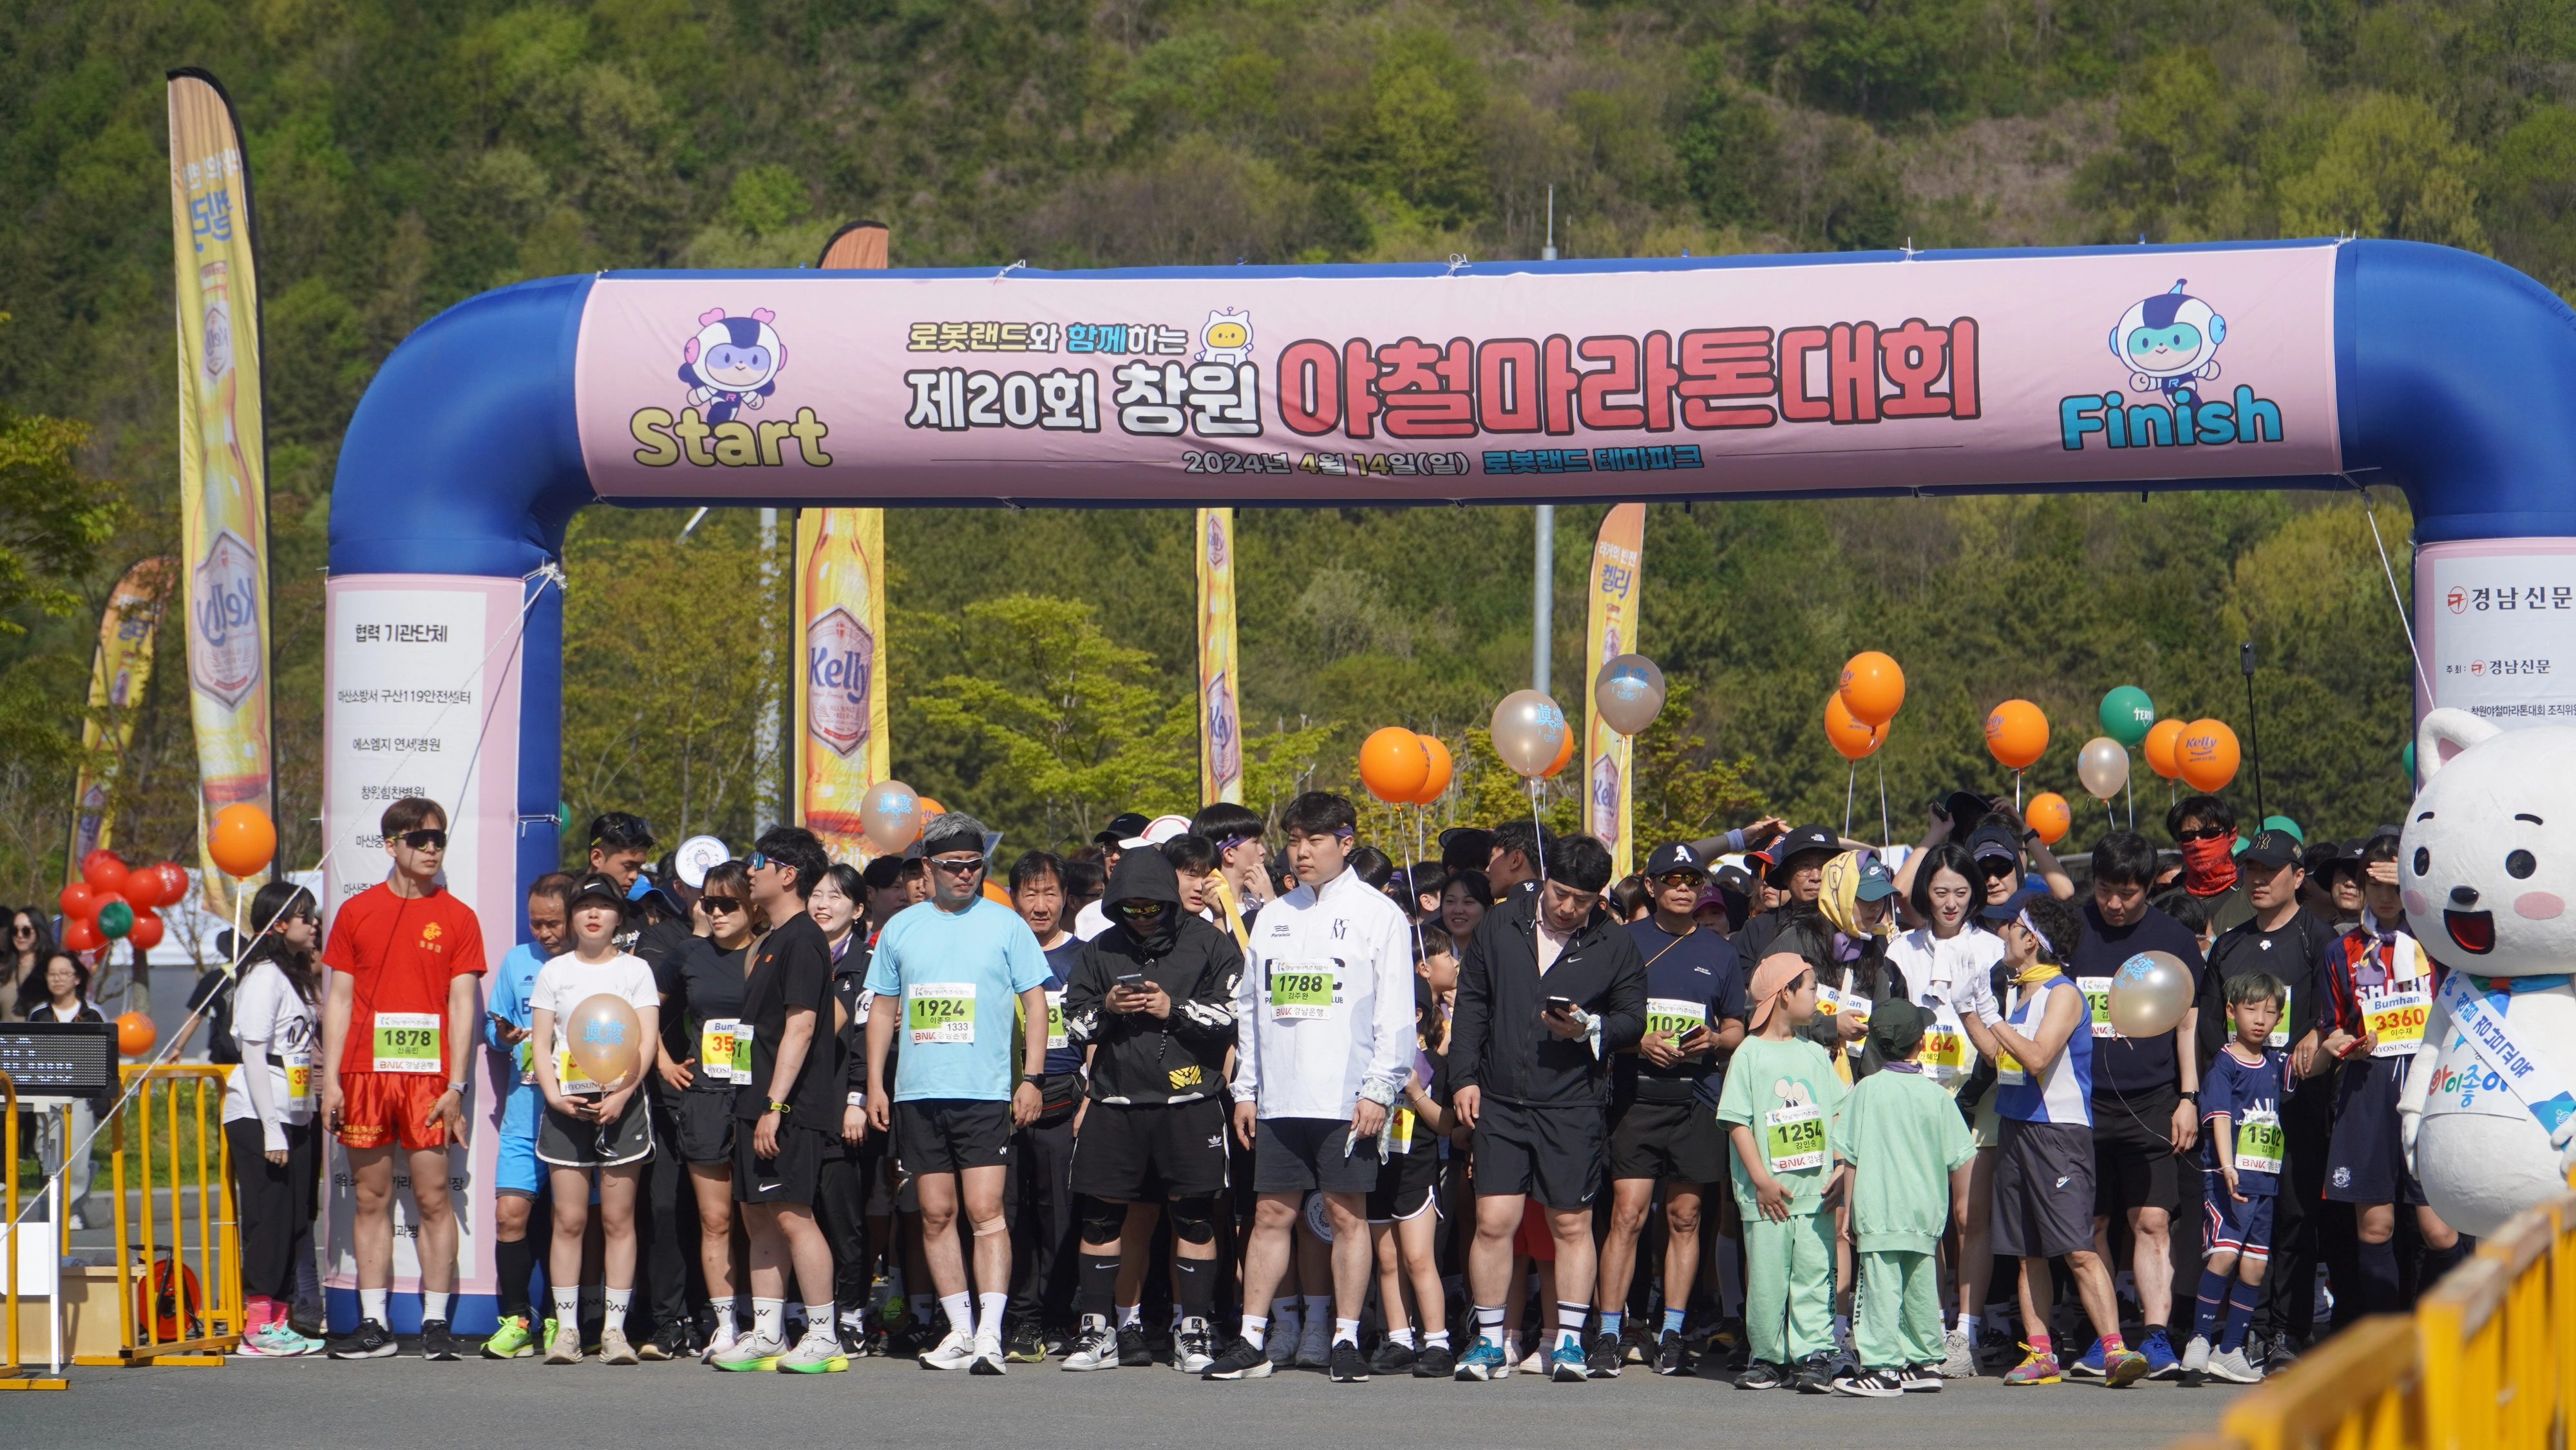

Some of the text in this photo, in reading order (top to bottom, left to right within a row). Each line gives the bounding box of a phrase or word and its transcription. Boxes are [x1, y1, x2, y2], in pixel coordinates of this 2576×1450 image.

[906, 321, 1188, 356] 로봇랜드와 함께하는
[903, 316, 1982, 439] 제20회 창원 야철마라톤대회
[2060, 384, 2284, 451] Finish
[630, 407, 833, 468] Start
[1181, 444, 1705, 476] 2024년 4월 14일(일) 로봇랜드 테마파크
[1601, 564, 1632, 600] 켈리
[2472, 587, 2573, 611] 경남신문
[356, 625, 448, 643] 협력 기관단체
[810, 647, 869, 704] Kelly
[2489, 660, 2551, 675] 경남신문
[338, 689, 471, 704] 마산소방서 구산119안전센터
[353, 738, 440, 752] 에스엠지 연세병원
[2186, 736, 2217, 750] Kelly
[1674, 845, 1692, 863] A
[1279, 976, 1322, 991] 1788
[918, 1000, 965, 1016] 1924
[2374, 995, 2420, 1010] Bumhan
[1276, 1007, 1324, 1016] BNK 경남은행
[2375, 1008, 2424, 1031] 3360
[947, 1023, 969, 1032] 1333
[384, 1030, 431, 1046] 1878
[937, 1032, 968, 1040] 경남은행
[2371, 1043, 2413, 1054] HYOSUNG
[2472, 1015, 2535, 1078] 경남교육
[406, 1062, 434, 1070] 경남은행
[1778, 1121, 1823, 1143] 1254
[2248, 1127, 2280, 1147] 1502
[1779, 1159, 1806, 1169] BNK
[2242, 1159, 2266, 1169] BNK
